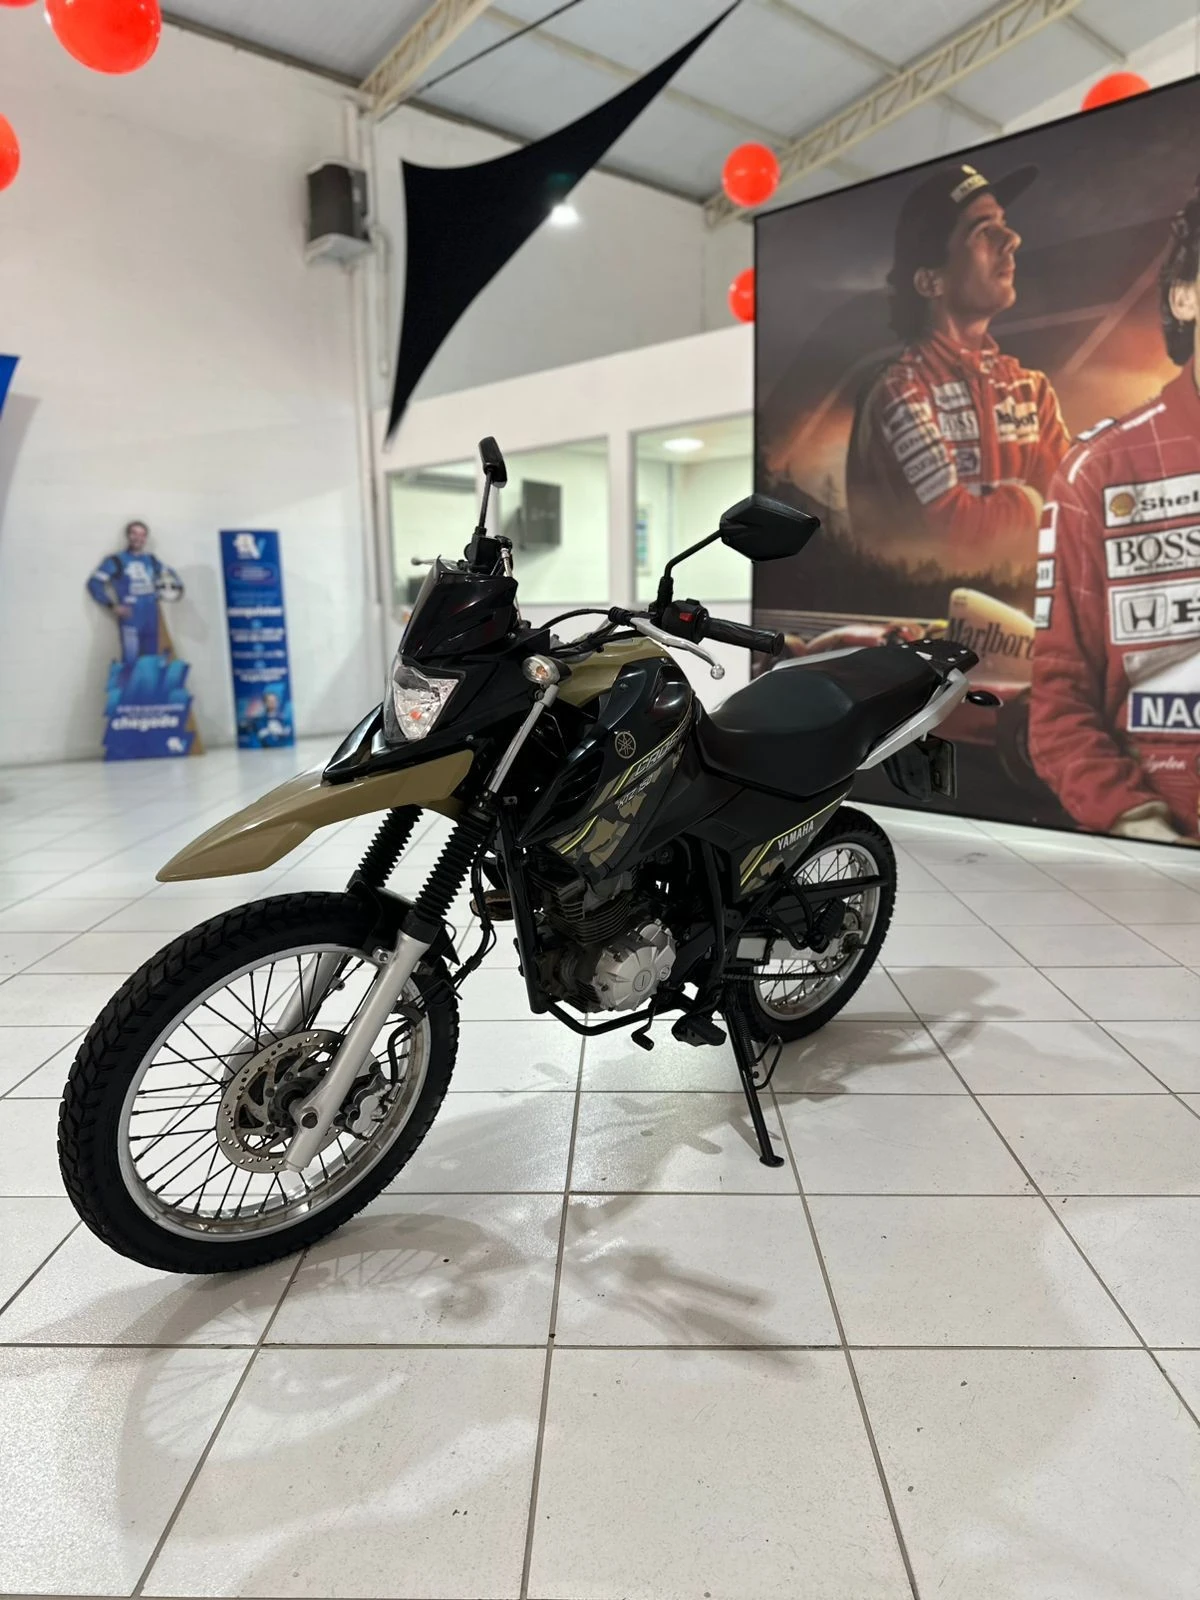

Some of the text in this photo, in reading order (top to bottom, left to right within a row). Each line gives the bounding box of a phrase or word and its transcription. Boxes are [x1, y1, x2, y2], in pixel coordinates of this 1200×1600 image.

[1113, 529, 1200, 567] BOSS
[1140, 696, 1200, 729] NA
[777, 819, 814, 851] YAMAHA
